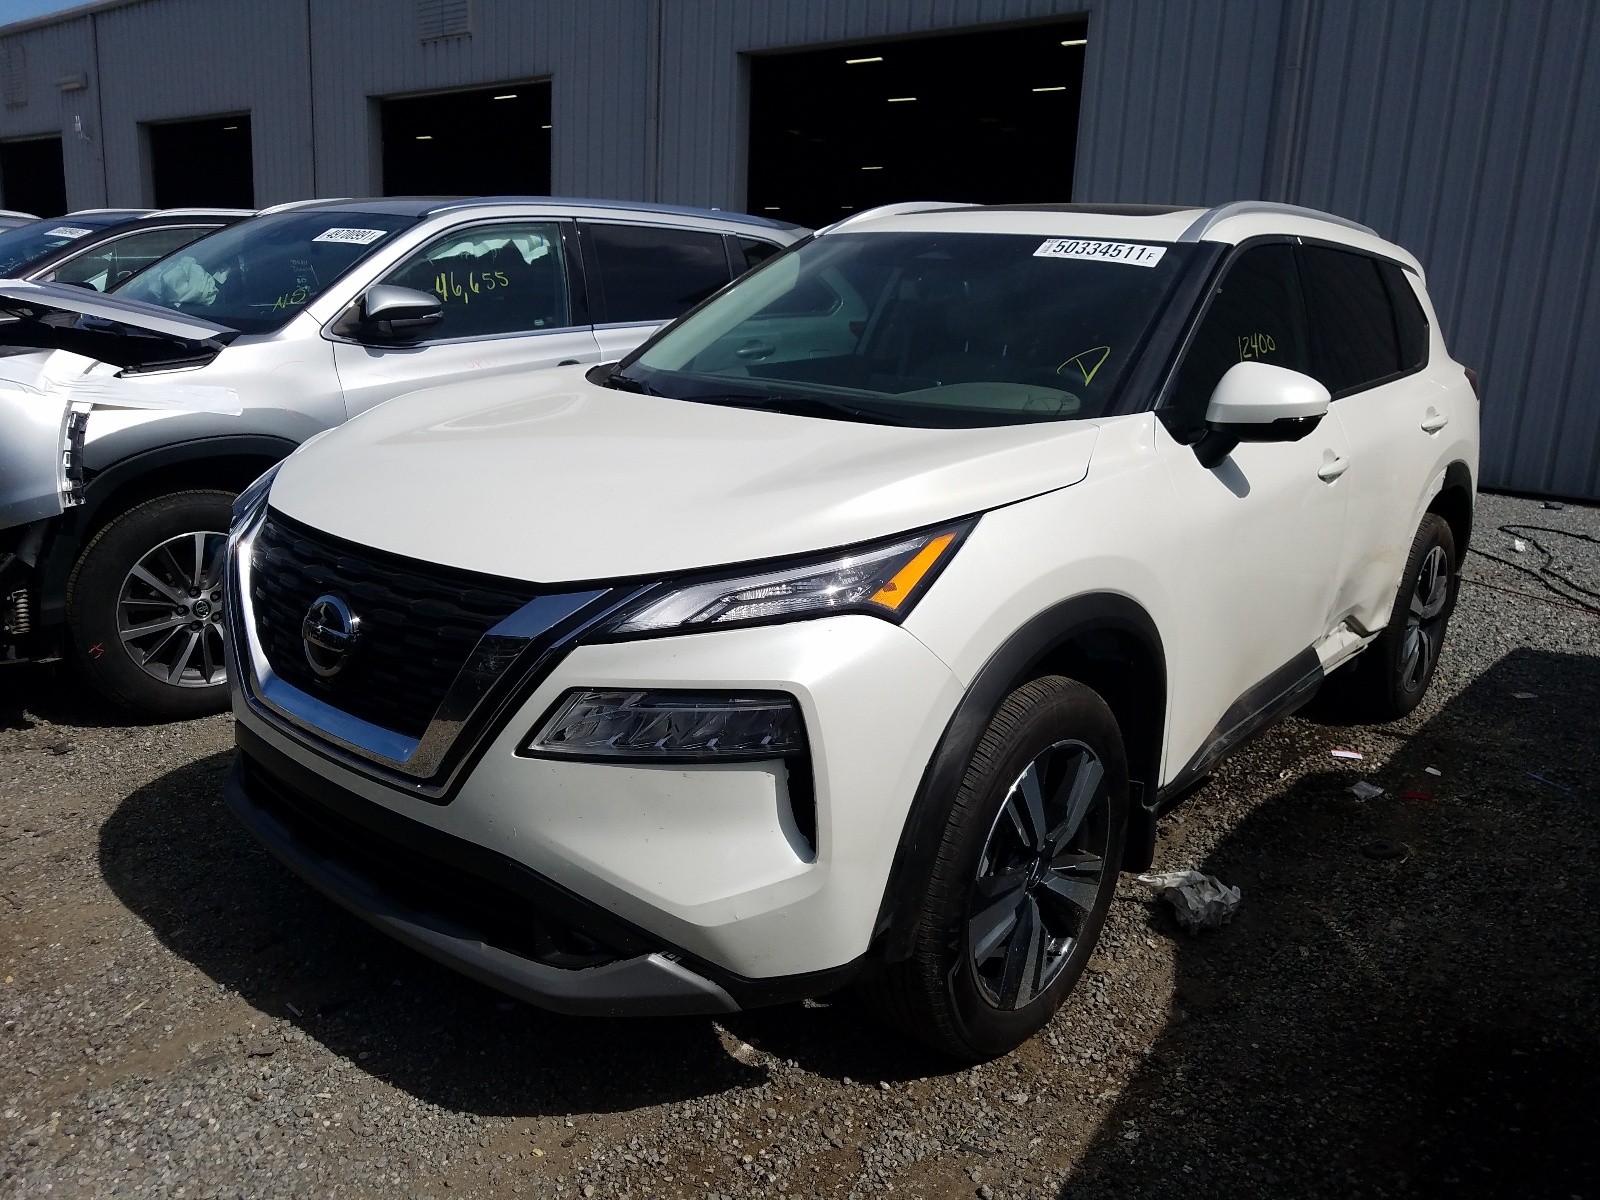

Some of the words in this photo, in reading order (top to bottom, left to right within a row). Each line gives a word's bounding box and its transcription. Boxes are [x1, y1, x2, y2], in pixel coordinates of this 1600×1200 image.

[1052, 240, 1145, 261] 50334511
[435, 271, 509, 304] 46,655
[1238, 332, 1276, 362] 12400
